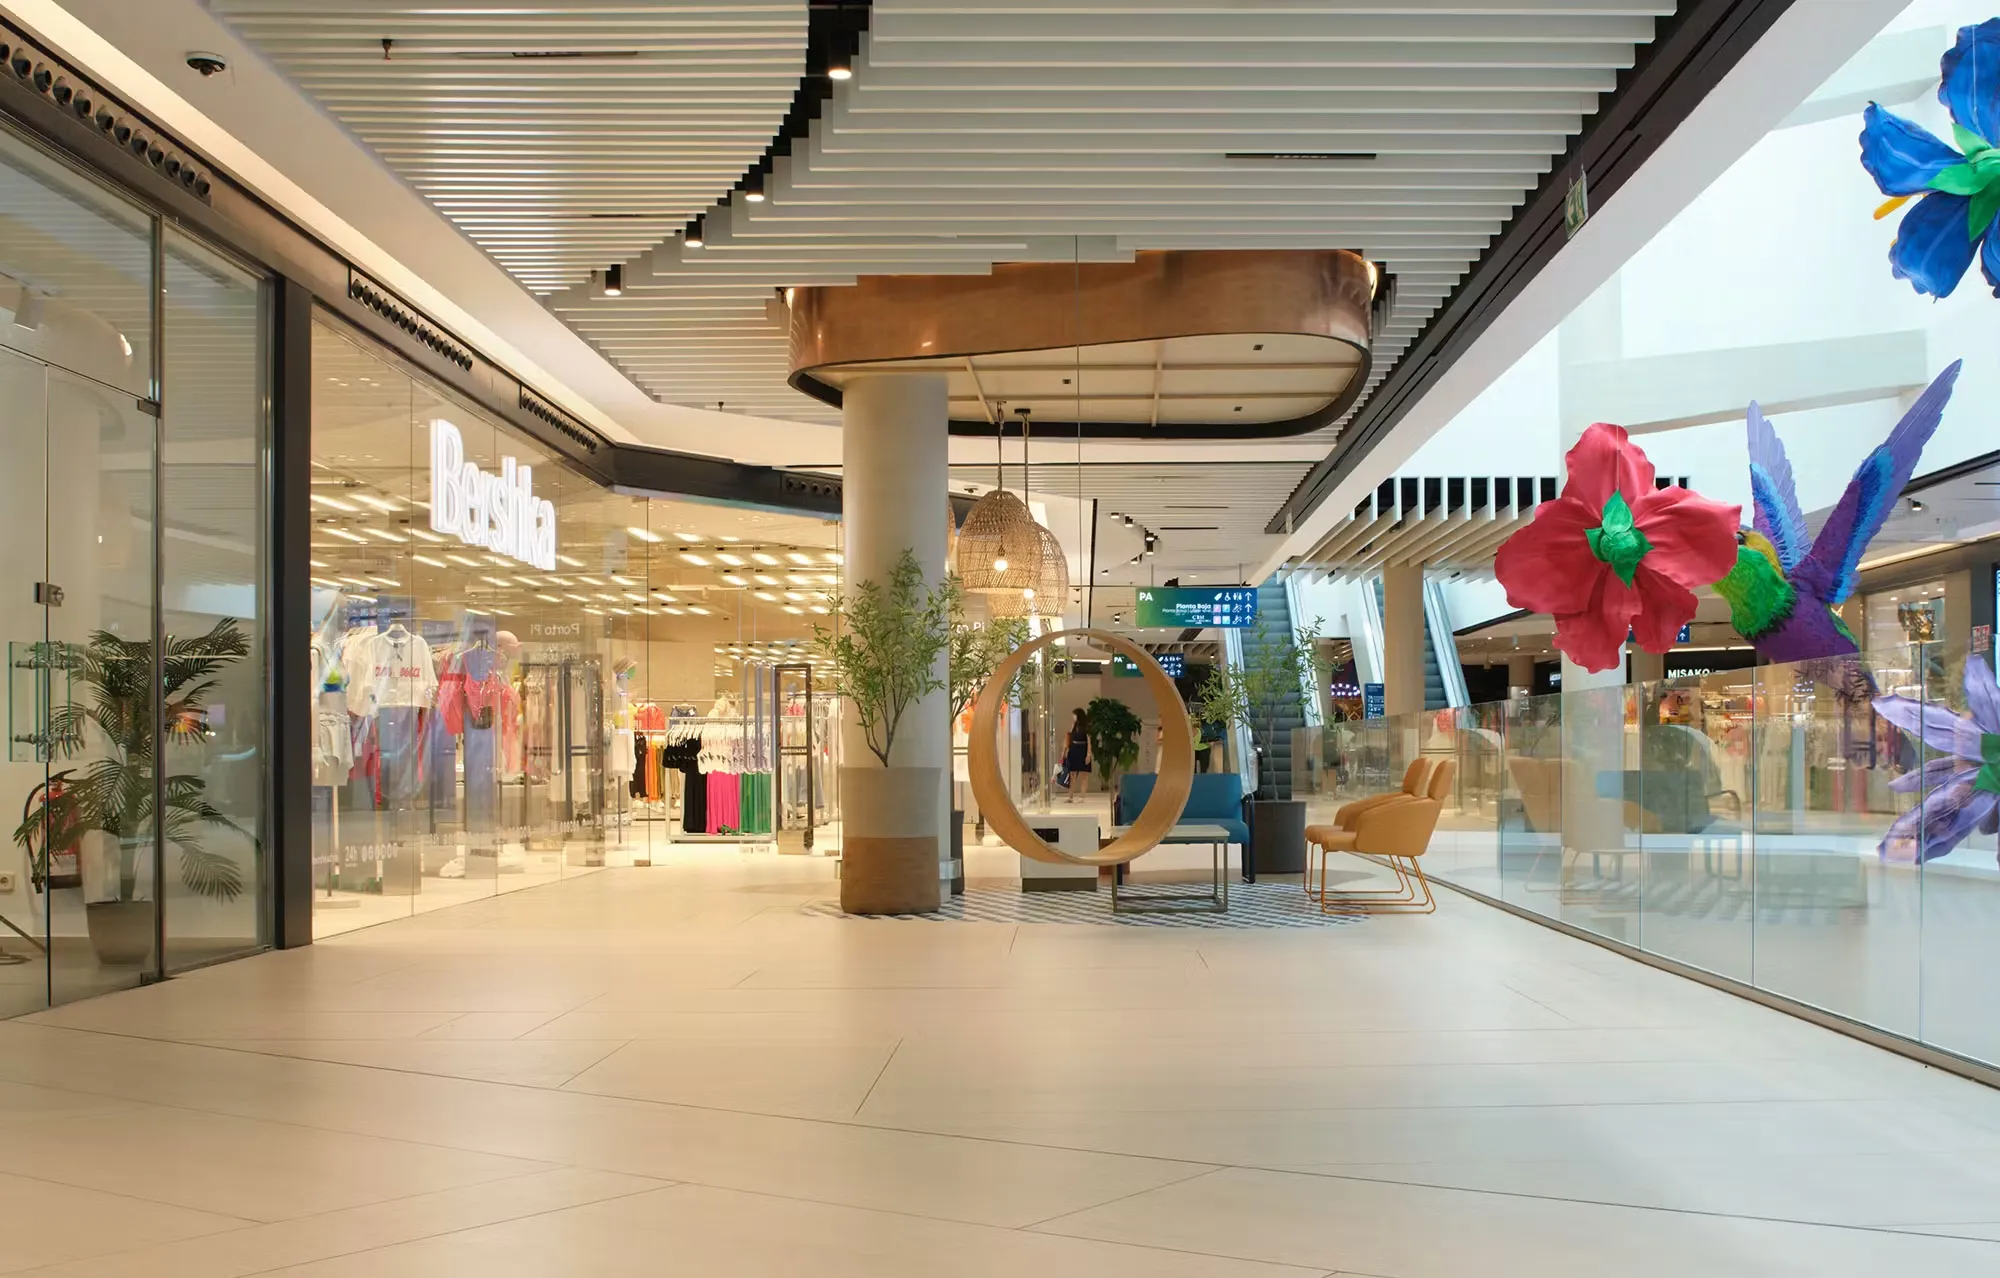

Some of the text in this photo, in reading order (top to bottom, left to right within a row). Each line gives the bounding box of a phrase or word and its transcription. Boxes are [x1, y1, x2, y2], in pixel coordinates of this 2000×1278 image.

[430, 419, 555, 570] Bershka
[1140, 592, 1153, 601] PA
[1668, 668, 1710, 679] MISAKO
